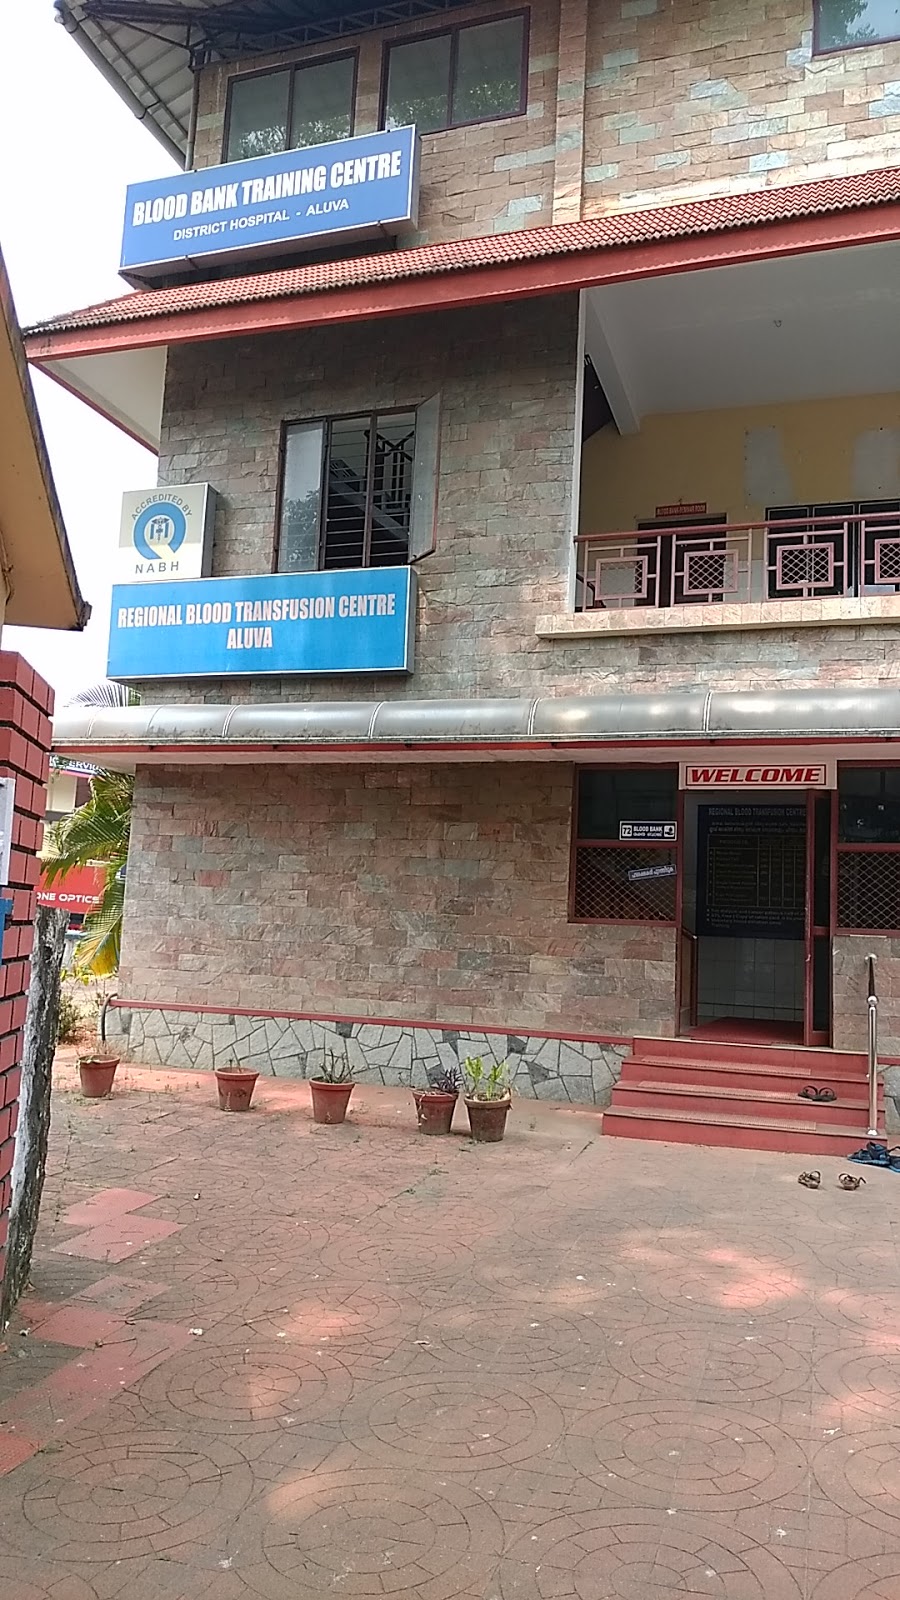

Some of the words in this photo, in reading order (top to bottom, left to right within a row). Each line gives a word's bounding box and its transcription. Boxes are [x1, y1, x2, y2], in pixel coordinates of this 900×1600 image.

[132, 193, 188, 226] BLOOD
[190, 182, 239, 216] BANK
[241, 164, 327, 205] TRAINING
[329, 150, 403, 189] CENTRE
[173, 220, 228, 241] DISTRICT
[230, 209, 290, 231] HOSPITAL
[305, 198, 350, 217] ALUVA
[131, 493, 183, 521] ACCREDITED
[182, 504, 193, 517] BY
[135, 561, 179, 574] NABH
[117, 604, 183, 629] REGIONAL
[185, 601, 232, 625] BLOOD
[234, 596, 336, 622] TRANSFUSION
[338, 592, 396, 618] CENTRE
[226, 626, 273, 650] ALUVA
[690, 767, 822, 783] WELCOME
[622, 827, 632, 835] 72
[58, 893, 100, 904] OPTICS
